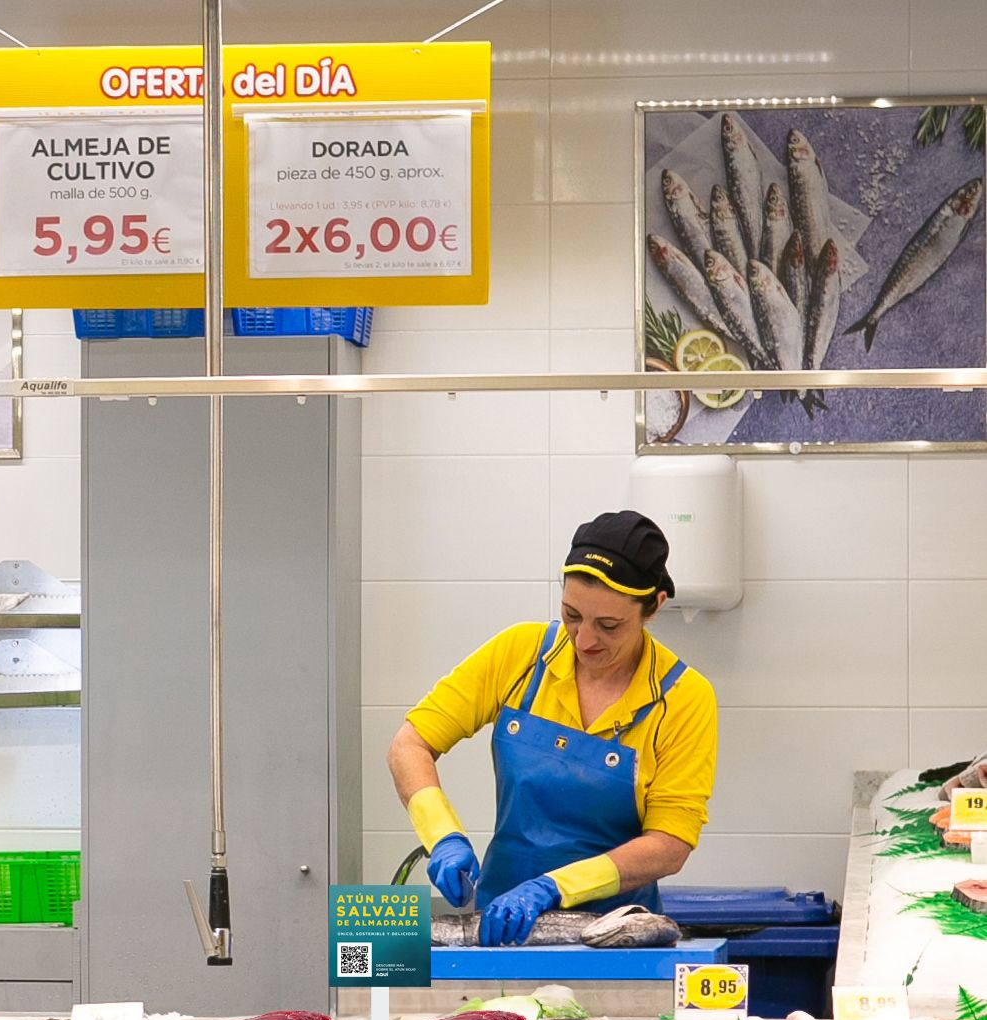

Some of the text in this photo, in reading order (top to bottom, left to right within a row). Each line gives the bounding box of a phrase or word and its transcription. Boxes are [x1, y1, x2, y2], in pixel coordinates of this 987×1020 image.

[101, 57, 357, 98] OFERT del DÍA
[31, 136, 171, 157] ALMEJA DE
[312, 140, 409, 158] DORADA
[47, 161, 155, 181] CULTIVO
[277, 165, 445, 182] pieza de 450 g. aprox.
[50, 186, 152, 200] malla de 500 g.
[270, 201, 314, 210] Llevando
[336, 892, 419, 903] ATÚN ROJO
[336, 905, 419, 917] SALVAJE
[354, 919, 419, 927] ALMADRABA
[700, 978, 737, 997] 8,95
